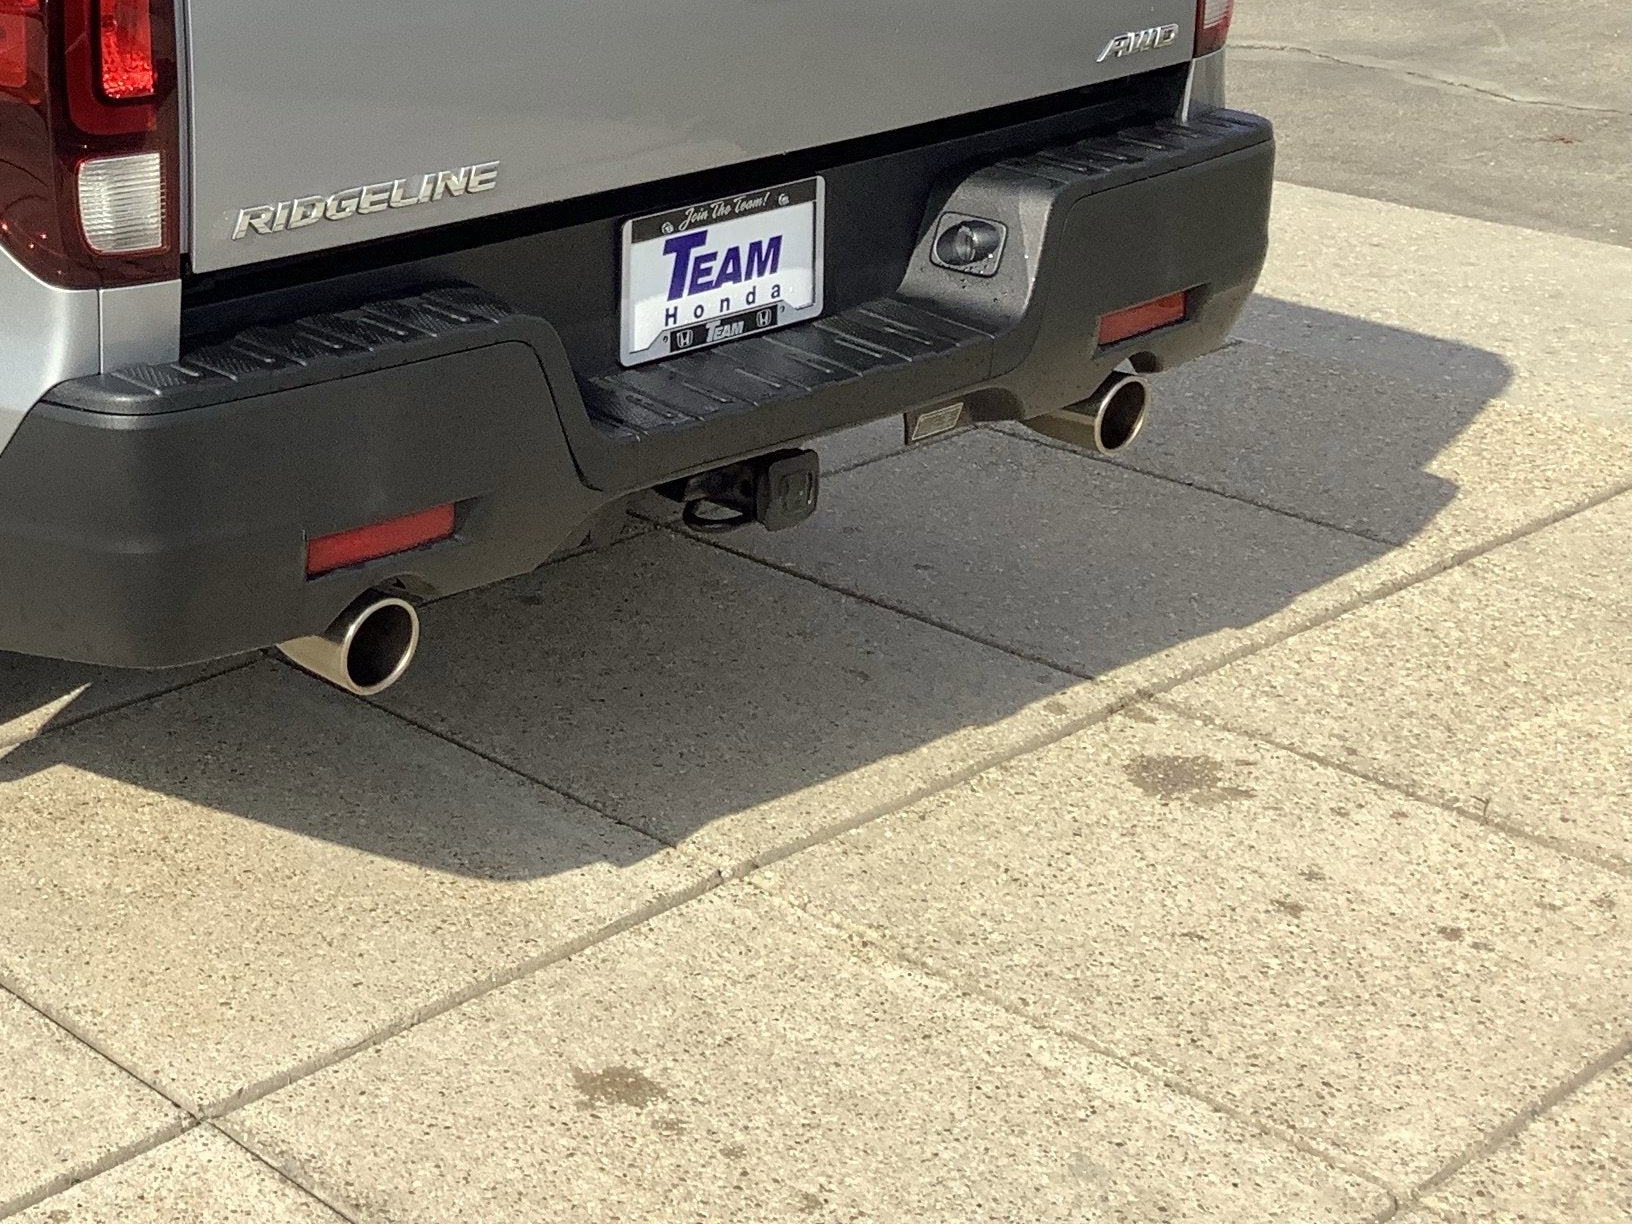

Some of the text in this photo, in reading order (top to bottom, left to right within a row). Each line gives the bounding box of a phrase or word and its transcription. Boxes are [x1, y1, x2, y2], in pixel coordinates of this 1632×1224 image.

[1096, 23, 1179, 63] AWD
[232, 160, 500, 240] RIDGELINE
[678, 192, 770, 231] Join The Team!
[663, 229, 784, 302] TEAM
[665, 283, 782, 327] Honda
[705, 320, 745, 343] TEAM
